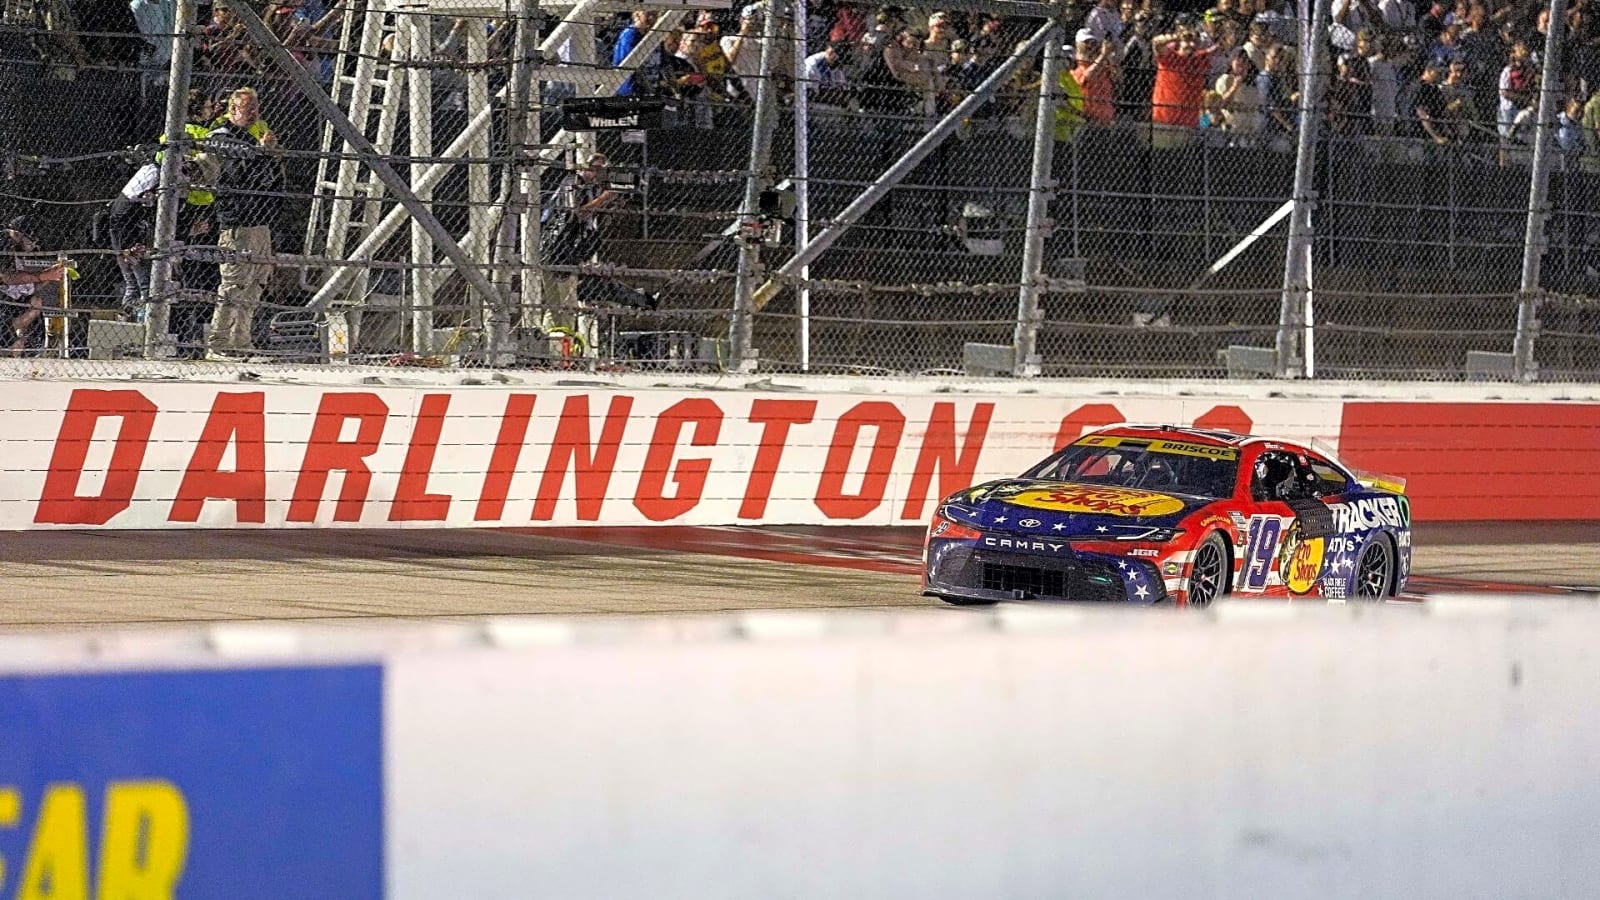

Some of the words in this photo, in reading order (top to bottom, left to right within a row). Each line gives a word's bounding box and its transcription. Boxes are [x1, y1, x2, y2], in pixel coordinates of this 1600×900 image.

[588, 115, 639, 127] WHELEN
[34, 389, 996, 524] DARLINGTON
[1162, 442, 1230, 457] BRISCOE
[1324, 497, 1402, 533] TRACKER
[985, 537, 1065, 552] CAMRY
[1127, 548, 1160, 558] JGR
[1238, 515, 1282, 592] 19
[1324, 586, 1347, 598] COFFEE
[0, 778, 192, 900] AR
